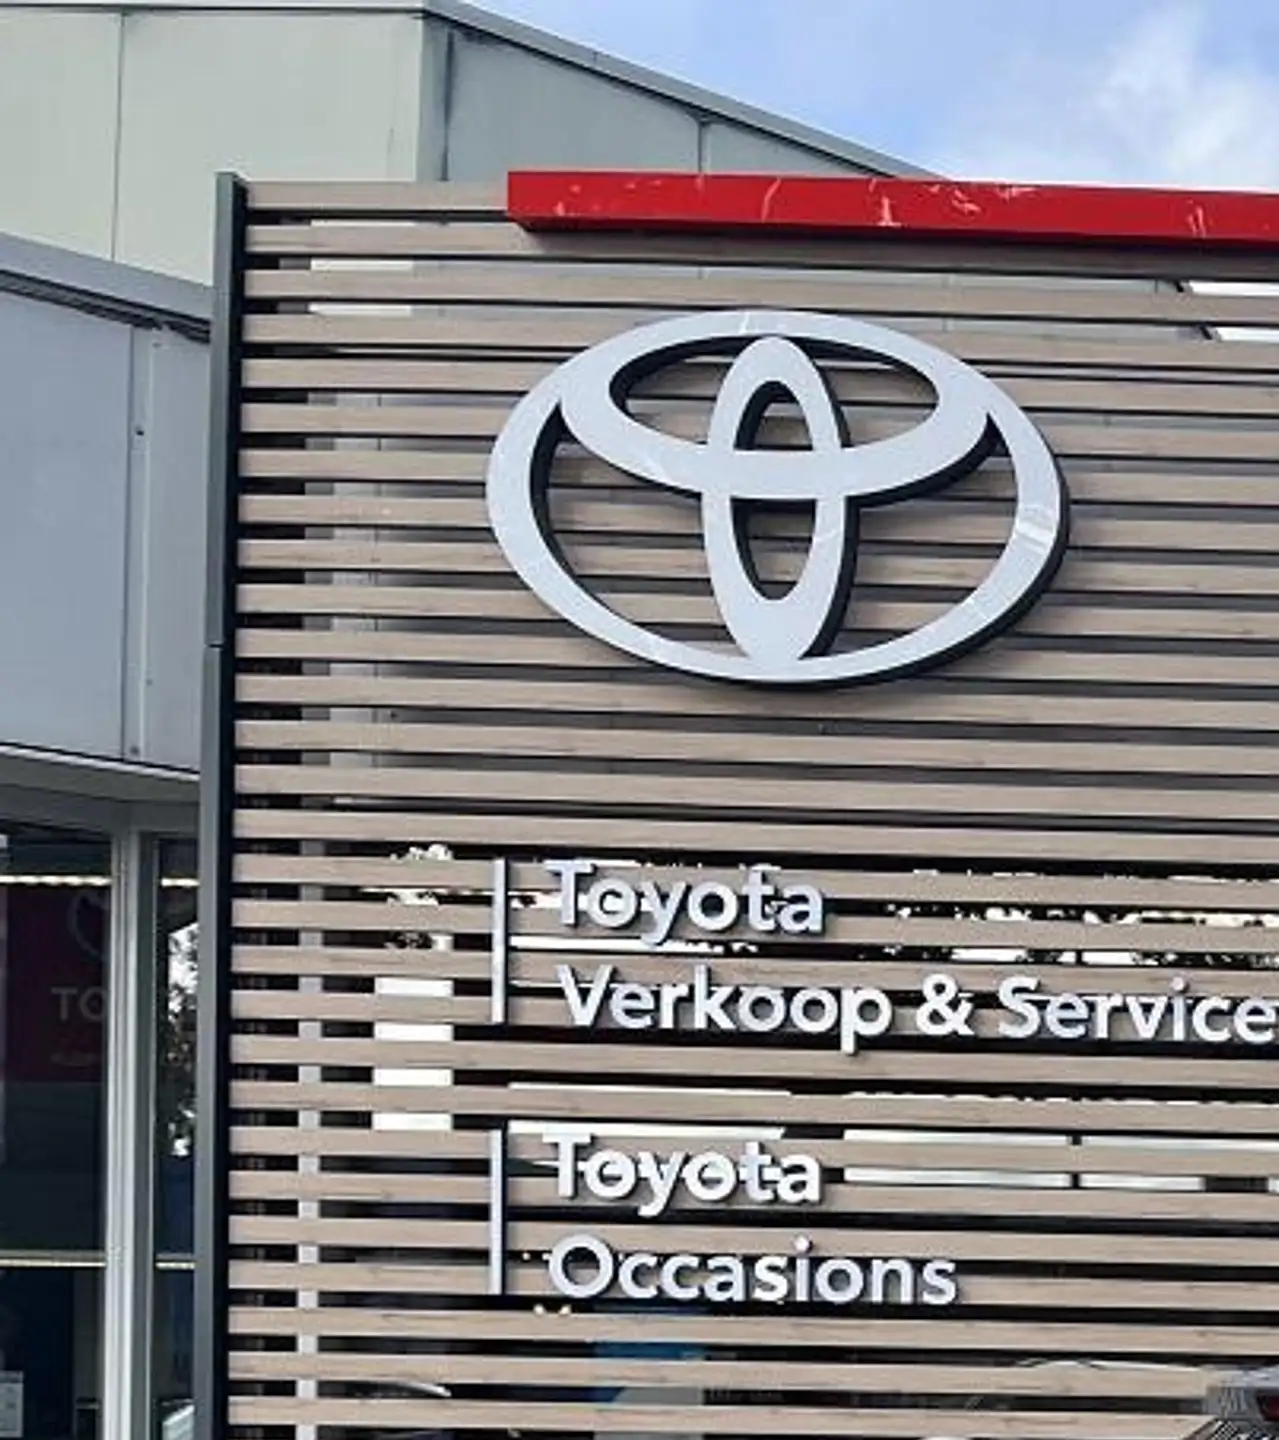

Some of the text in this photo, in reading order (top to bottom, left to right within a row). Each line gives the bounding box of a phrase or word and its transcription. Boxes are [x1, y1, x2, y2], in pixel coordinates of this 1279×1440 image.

[545, 859, 825, 945] Toyota
[556, 964, 1278, 1055] Verkoop & Service
[542, 1130, 823, 1217] Toyota
[547, 1234, 958, 1304] Occasions
